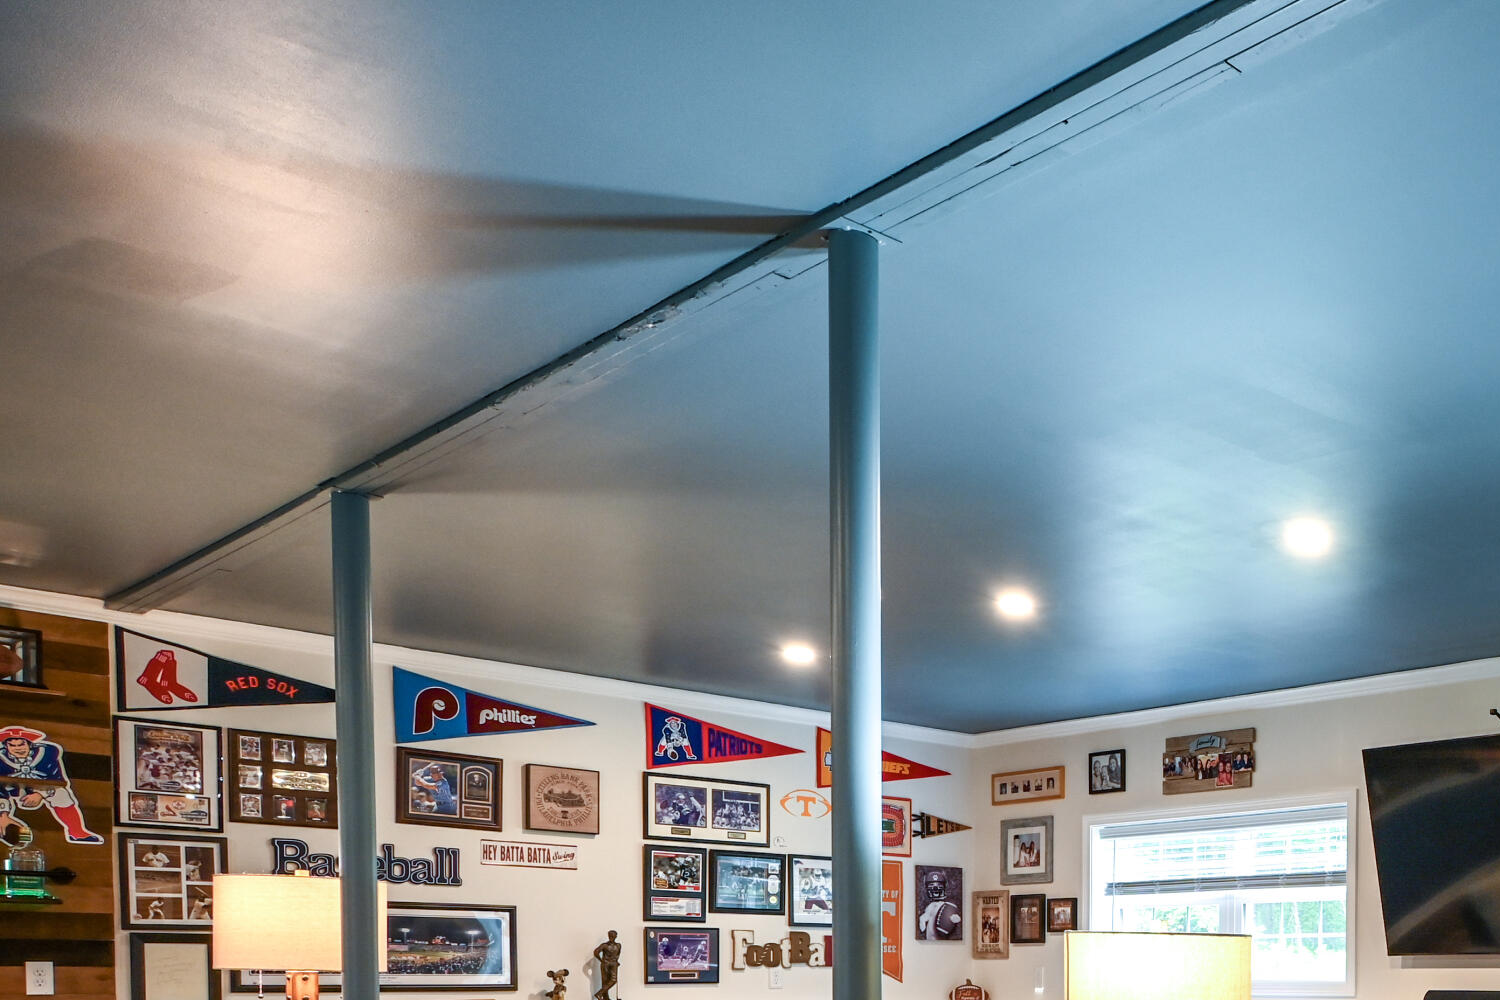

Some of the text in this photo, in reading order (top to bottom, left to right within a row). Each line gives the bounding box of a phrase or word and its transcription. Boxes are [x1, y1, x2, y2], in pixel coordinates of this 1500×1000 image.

[225, 676, 299, 698] RED SOX
[708, 727, 763, 758] PATRIOTS
[882, 760, 911, 775] IEFS
[536, 773, 560, 794] CITIZENS
[560, 772, 580, 783] BANK
[578, 781, 593, 799] PARK
[536, 797, 573, 827] PHILADELPHIA
[796, 795, 817, 817] T
[482, 843, 575, 864] HEY BATTA BATTA Swing
[731, 929, 832, 970] FootBa
